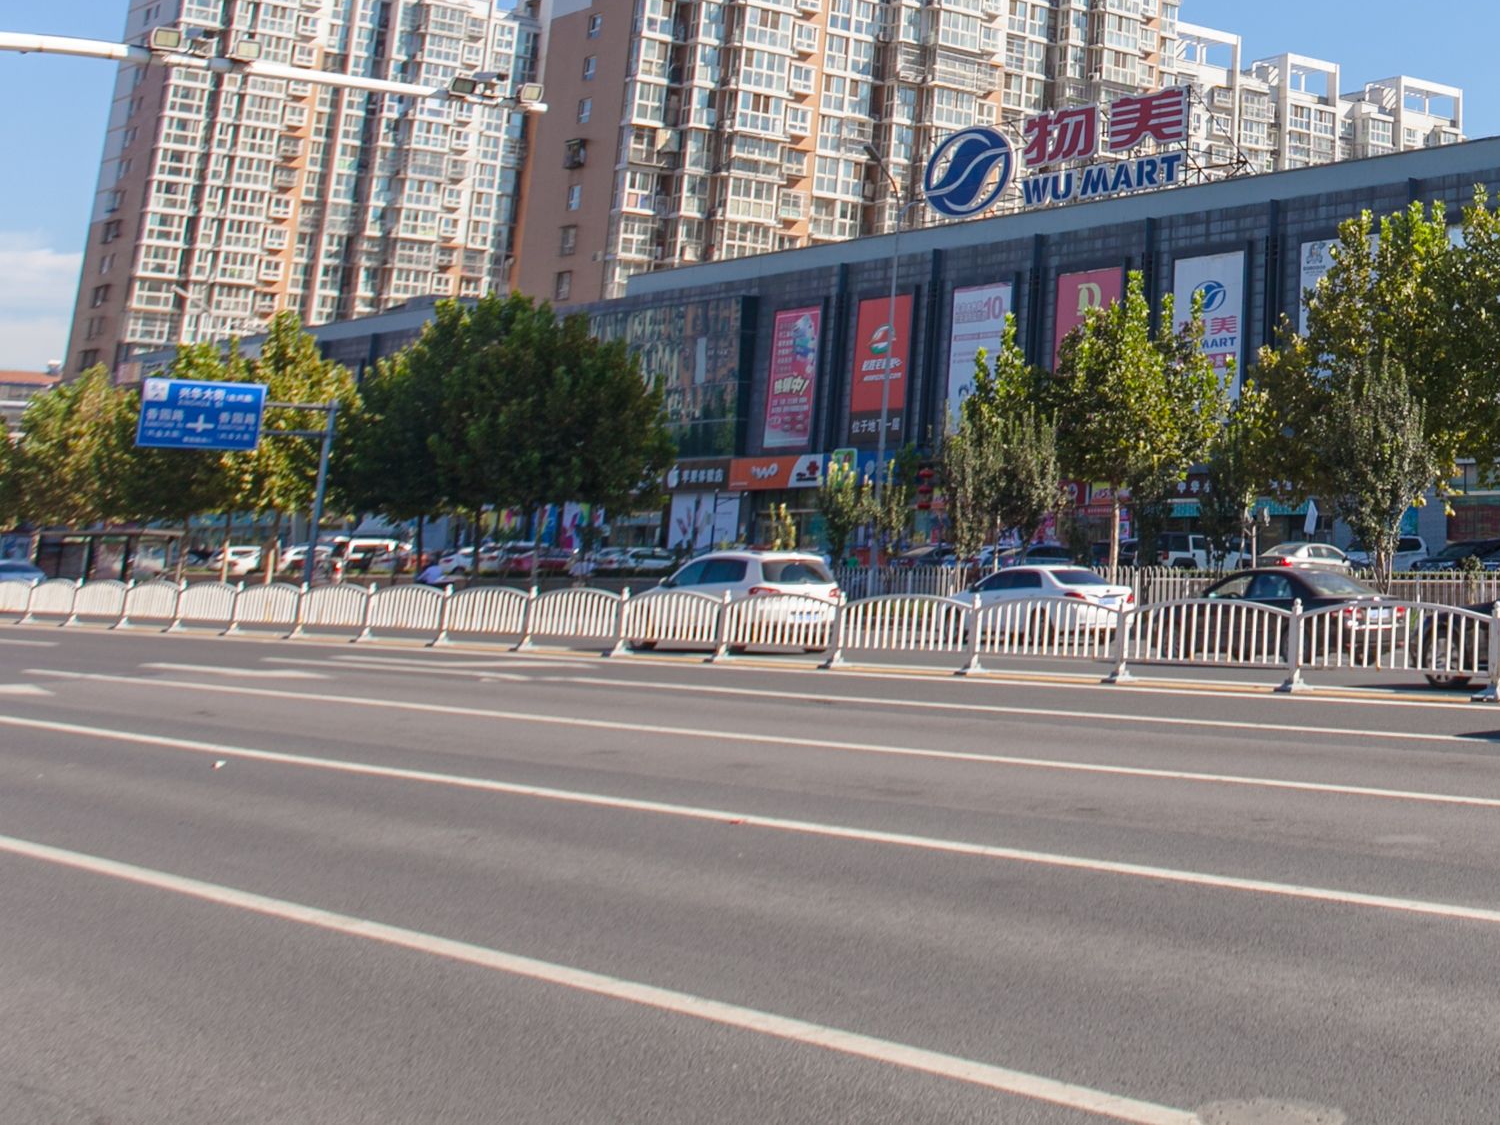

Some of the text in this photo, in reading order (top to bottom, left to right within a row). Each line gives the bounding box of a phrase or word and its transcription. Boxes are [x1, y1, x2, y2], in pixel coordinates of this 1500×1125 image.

[1024, 88, 1184, 166] 物美
[1023, 154, 1182, 205] WU MART
[984, 295, 1003, 321] 10
